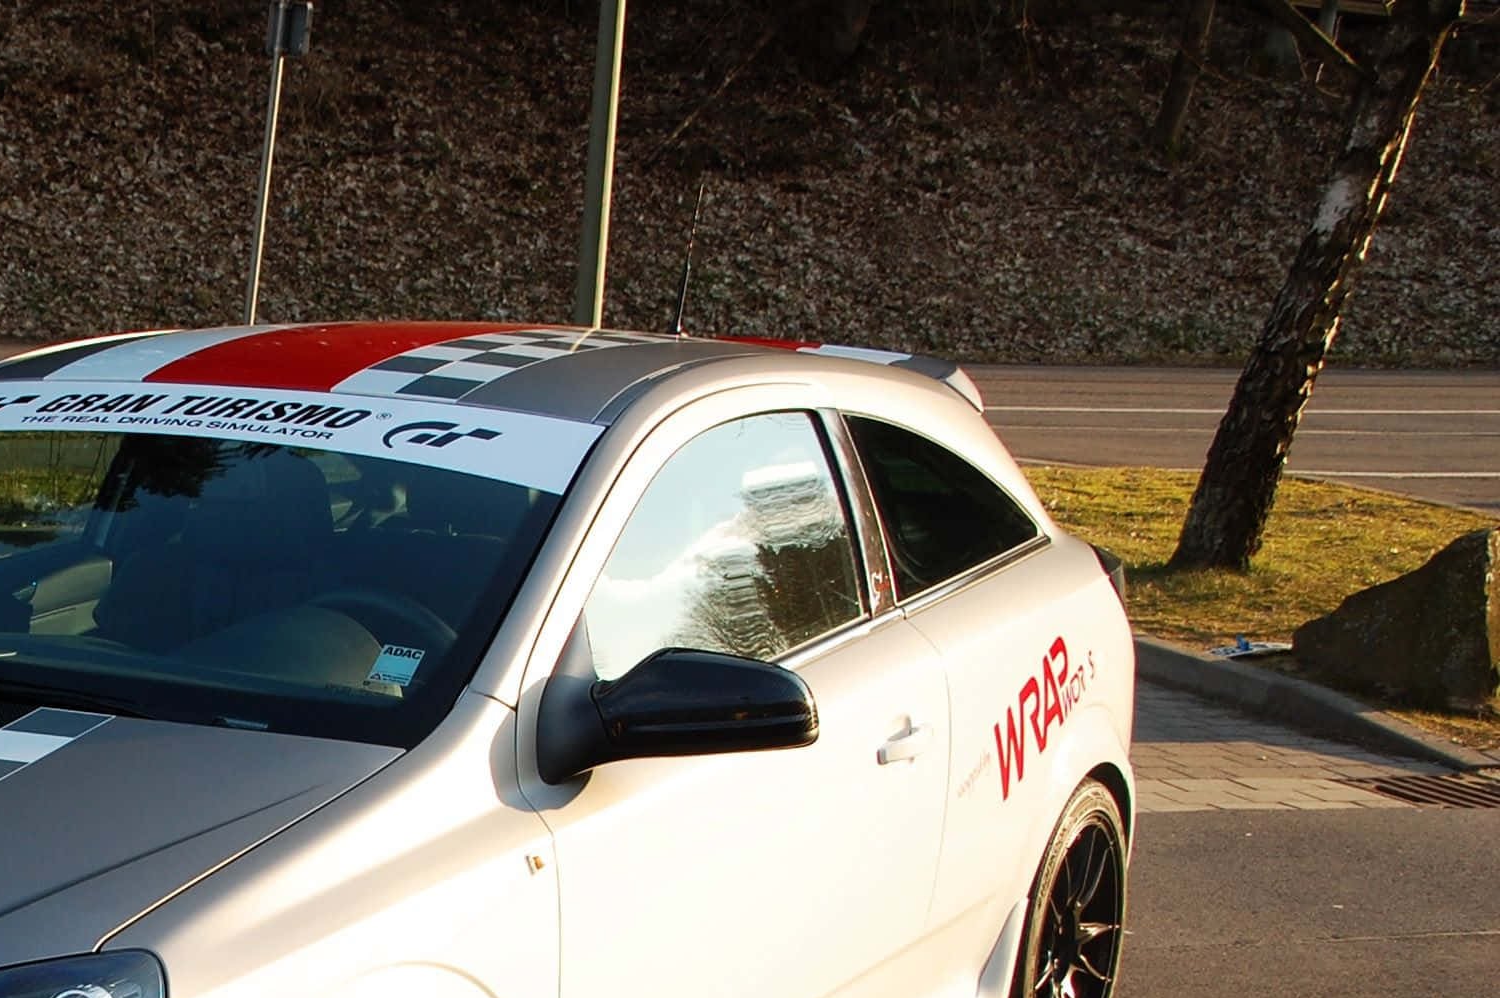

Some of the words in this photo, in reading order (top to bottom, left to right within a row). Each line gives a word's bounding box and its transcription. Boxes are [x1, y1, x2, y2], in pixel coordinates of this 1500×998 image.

[36, 394, 168, 413] GRAN
[161, 395, 372, 429] TURISMO
[20, 415, 55, 423] THE
[61, 415, 109, 424] REAL
[117, 416, 202, 428] DRIVING
[206, 420, 333, 440] SIMULATOR
[383, 646, 422, 660] ADAC
[994, 636, 1068, 802] WRAP
